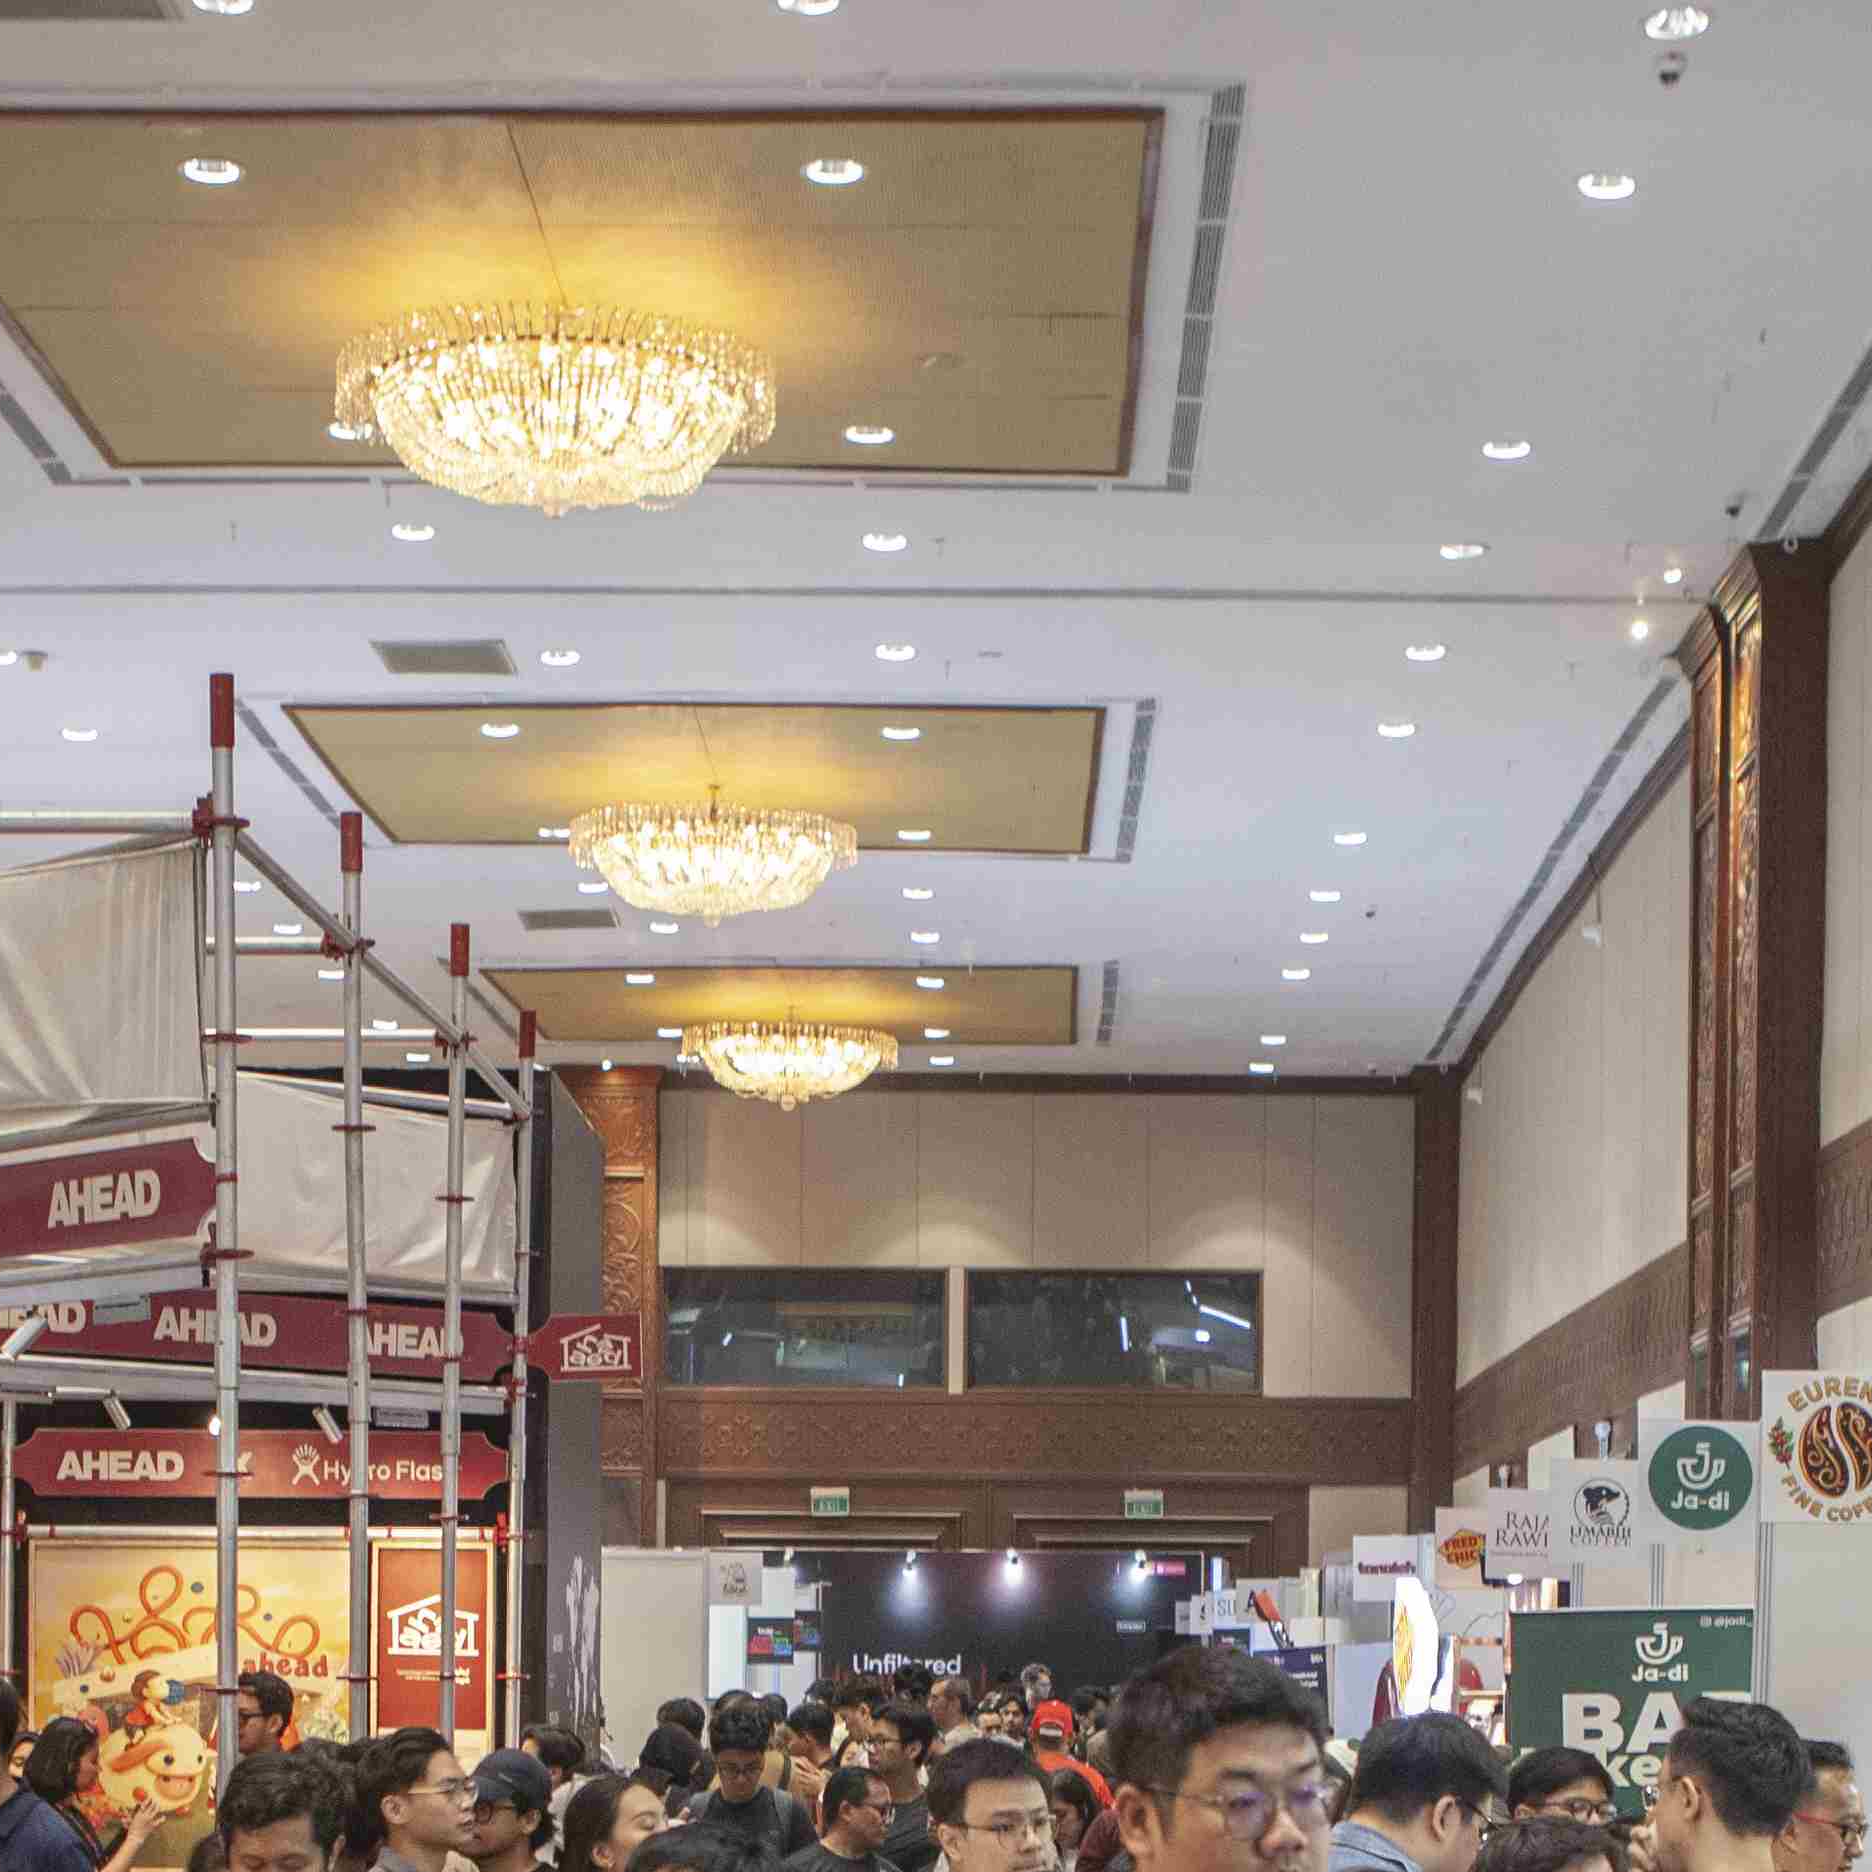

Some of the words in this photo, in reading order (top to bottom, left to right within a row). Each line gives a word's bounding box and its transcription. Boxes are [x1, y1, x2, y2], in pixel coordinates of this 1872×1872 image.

[48, 1169, 161, 1228] AHEAD
[57, 1449, 185, 1482] AHEAD
[323, 1460, 391, 1487] Hyro
[395, 1460, 443, 1482] Flas
[1670, 1490, 1730, 1511] Ja-di
[1780, 1474, 1824, 1519] FINE
[241, 1651, 329, 1678] ahead
[1631, 1664, 1689, 1683] Ja-di
